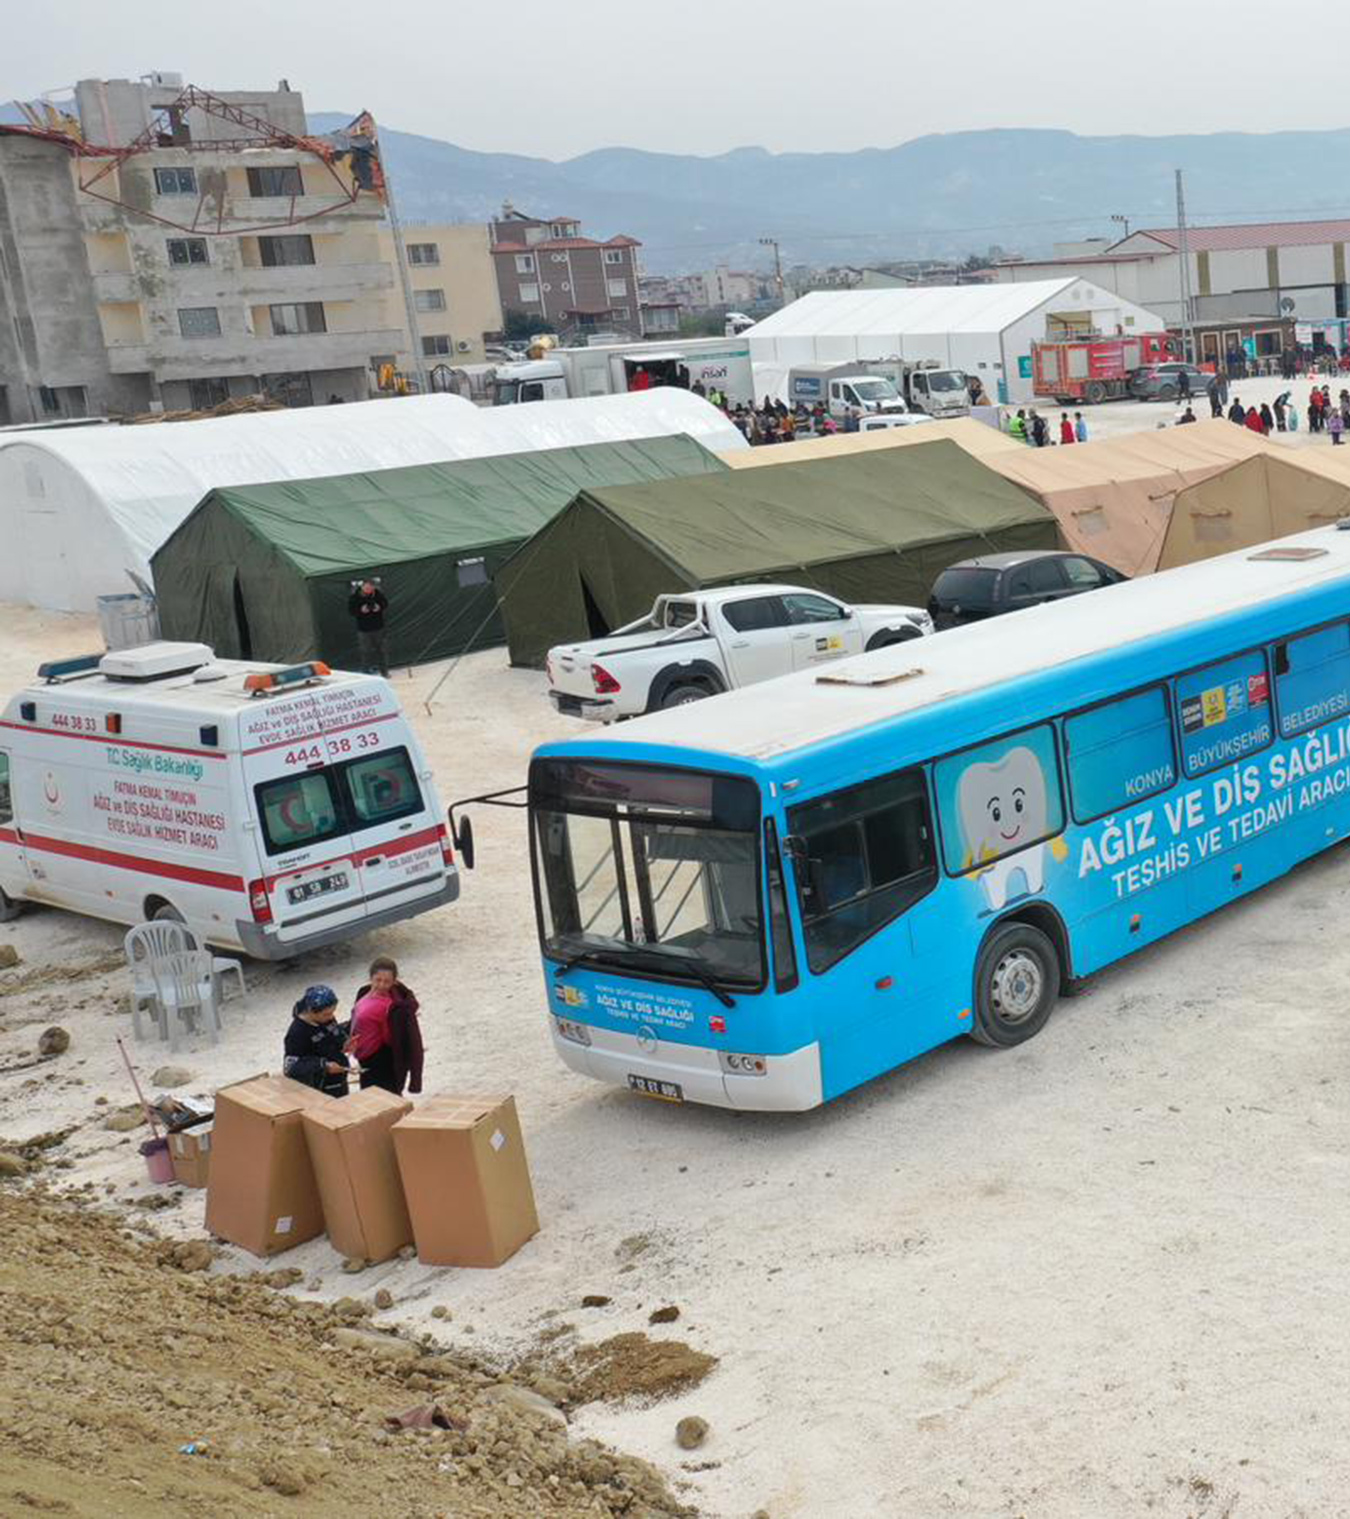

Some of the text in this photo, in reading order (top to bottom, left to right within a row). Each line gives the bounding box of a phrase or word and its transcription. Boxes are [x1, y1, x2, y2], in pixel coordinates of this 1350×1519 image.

[52, 713, 97, 732] 444 38 33
[285, 731, 380, 766] 444 38 33
[1124, 763, 1174, 798] KONYA
[1188, 722, 1271, 772] BÜYÜKŞEHİR
[1281, 689, 1349, 733] BELEDİYESİ
[121, 748, 153, 773] Sağlık
[154, 754, 203, 782] Bakanlığı
[1078, 809, 1158, 879] AĞIZ
[1163, 788, 1205, 837] VE
[1213, 762, 1261, 816] DİŞ
[1111, 765, 1350, 898] TEŞHİS VE TEDAVİ ARACI
[596, 993, 619, 1008] AĞIZ
[620, 998, 634, 1010] VE
[653, 1004, 695, 1023] SAĞLIĞI
